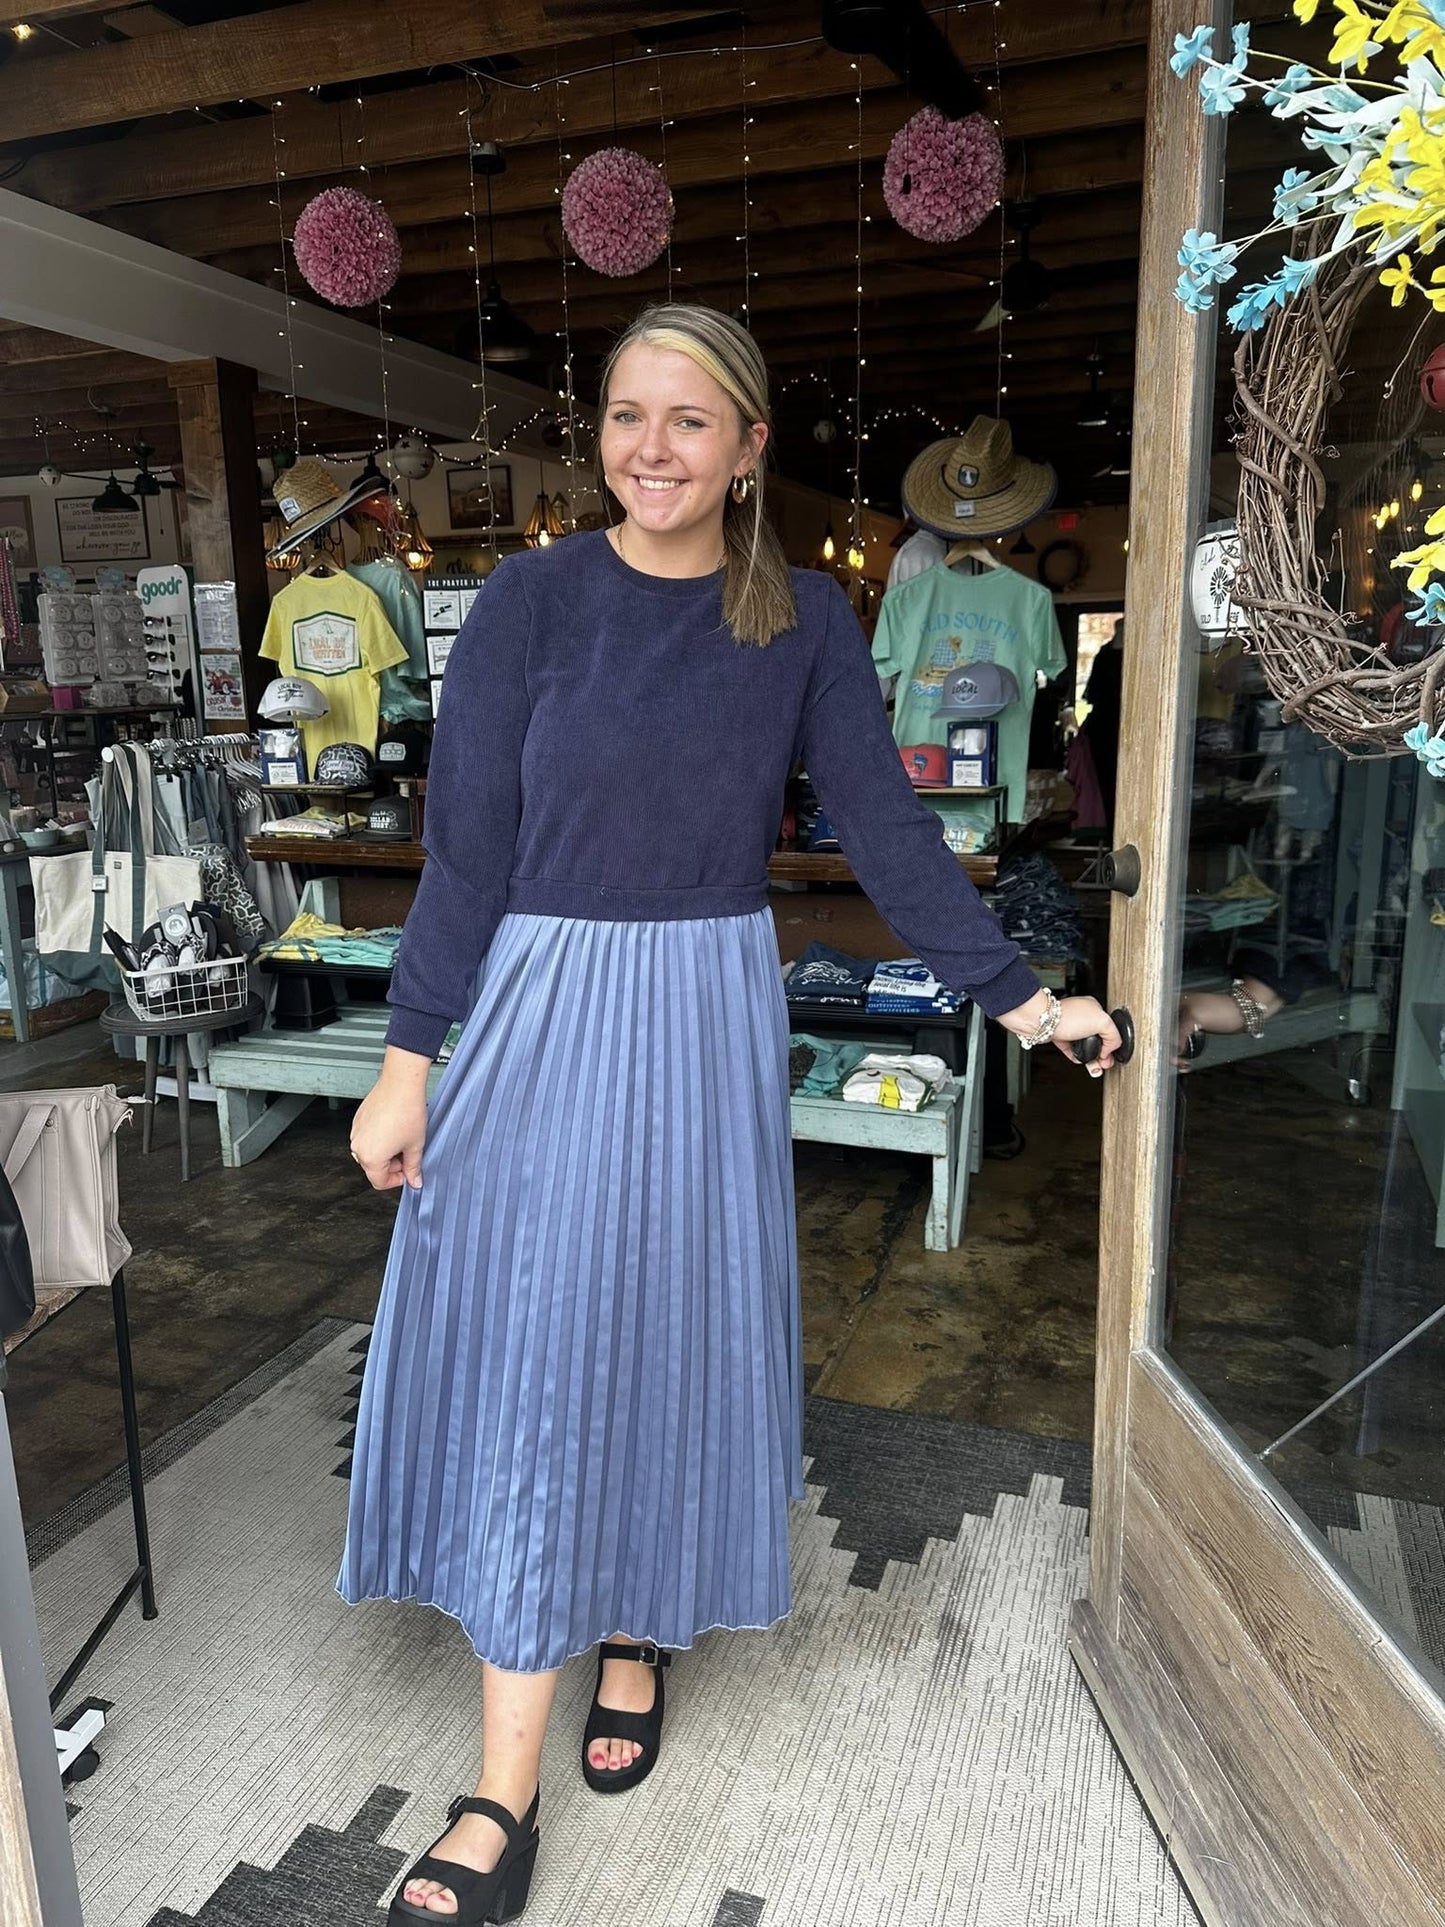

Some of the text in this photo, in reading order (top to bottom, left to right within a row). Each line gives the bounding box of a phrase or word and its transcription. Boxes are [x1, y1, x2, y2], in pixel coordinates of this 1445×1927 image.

[141, 576, 183, 605] goodr
[442, 579, 468, 587] PRAYER
[953, 611, 1019, 643] SOUTH
[951, 682, 980, 695] LOCAL
